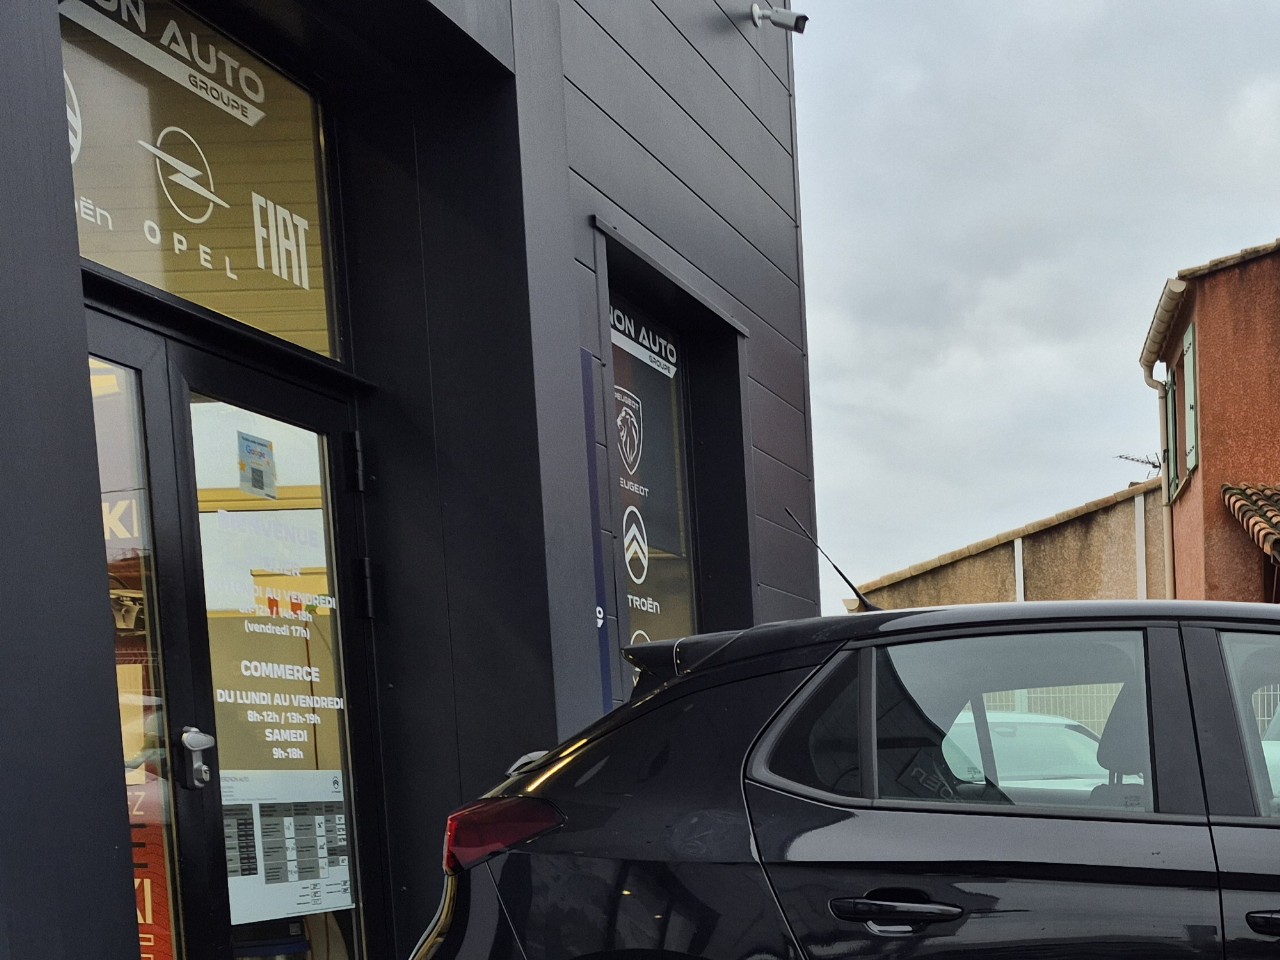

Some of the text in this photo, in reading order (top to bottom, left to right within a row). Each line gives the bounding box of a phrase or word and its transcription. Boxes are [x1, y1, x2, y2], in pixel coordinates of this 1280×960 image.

[95, 0, 265, 103] N AUTO
[187, 73, 249, 118] GROUPE
[144, 219, 238, 280] OPEL
[252, 191, 310, 290] FIAT
[639, 326, 677, 364] AUTO
[648, 355, 671, 374] GROUPE
[283, 590, 337, 609] VENDREDI
[245, 620, 310, 639] (vendredi 17h)
[241, 660, 320, 682] COMMERCE
[217, 689, 344, 709] DU LUNDI AU VENDREDI
[247, 711, 280, 723] 8h-12h
[287, 712, 320, 724] 13h-19h
[265, 729, 308, 742] SAMEDI
[272, 747, 304, 759] 9h-18h
